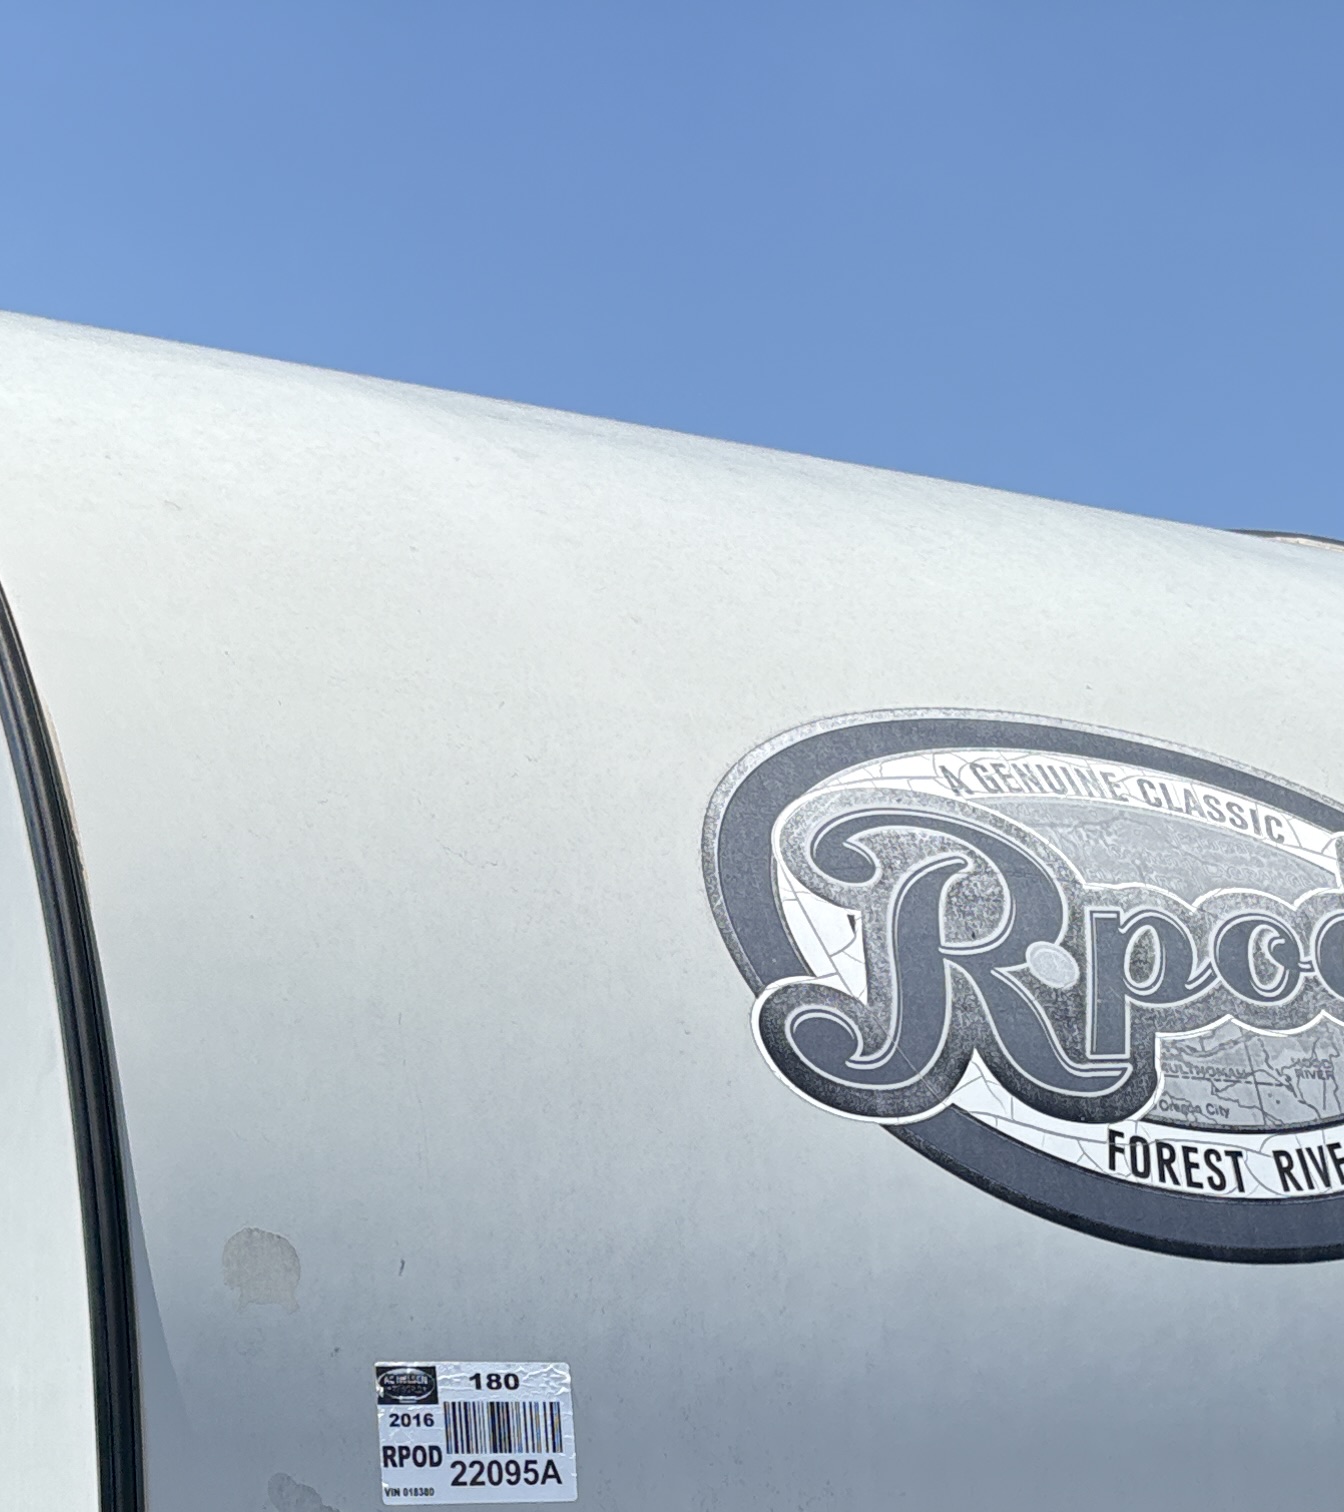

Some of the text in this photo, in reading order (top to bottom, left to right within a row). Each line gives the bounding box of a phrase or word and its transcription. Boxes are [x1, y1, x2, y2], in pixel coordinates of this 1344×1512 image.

[938, 762, 1288, 844] A GENUINE CLASSIC
[1206, 1103, 1230, 1119] City
[1108, 1129, 1246, 1193] FOREST
[469, 1373, 520, 1390] 180
[389, 1412, 434, 1428] 2016
[382, 1445, 443, 1468] RPOD
[450, 1459, 563, 1487] 22095A
[384, 1487, 400, 1497] VIN
